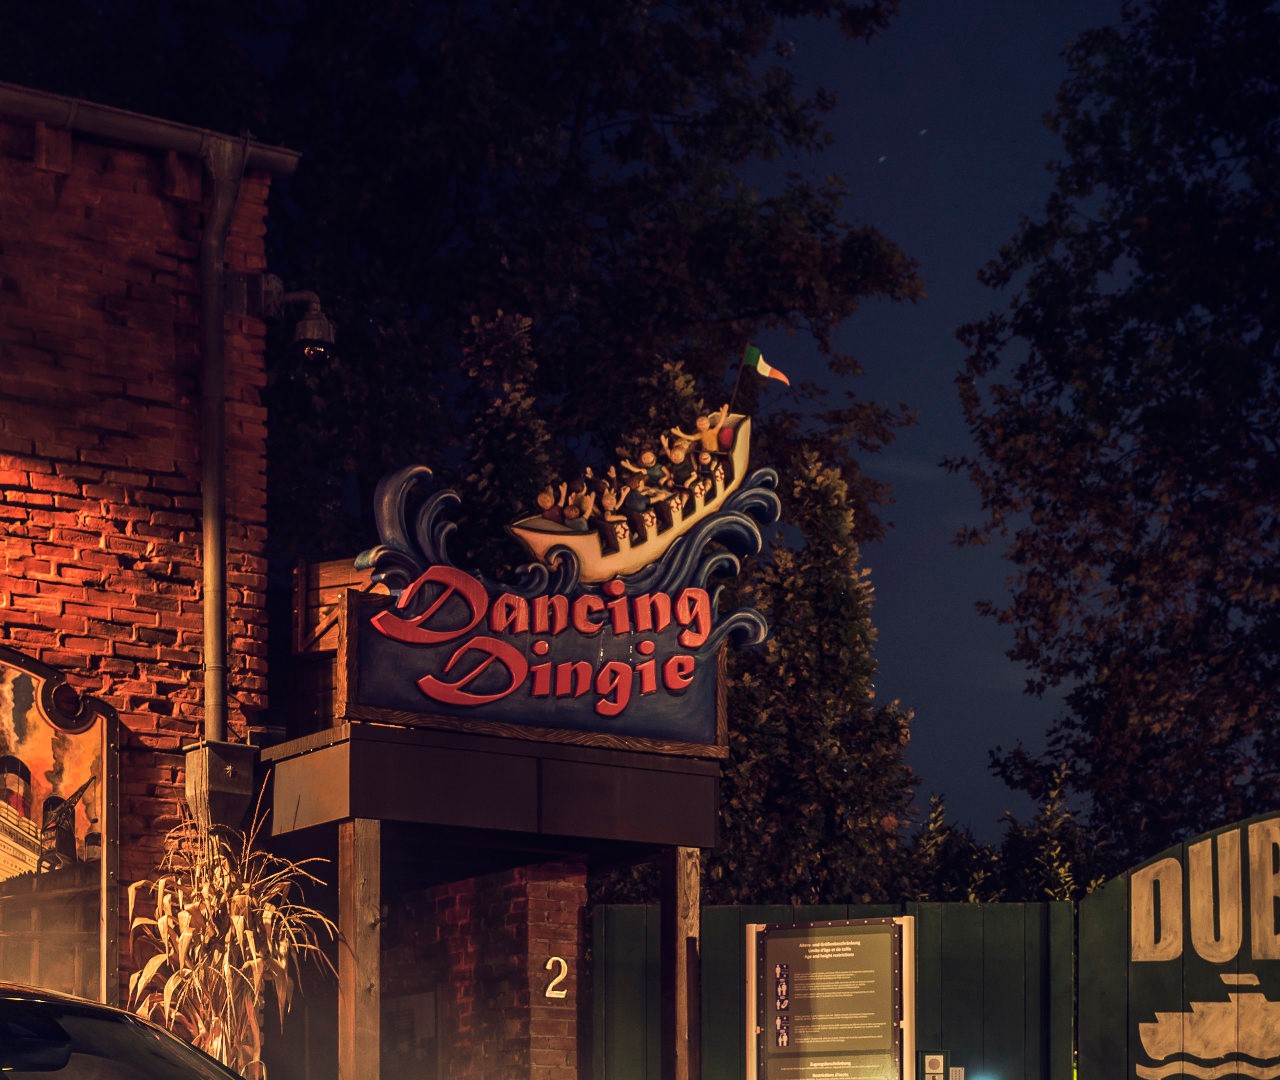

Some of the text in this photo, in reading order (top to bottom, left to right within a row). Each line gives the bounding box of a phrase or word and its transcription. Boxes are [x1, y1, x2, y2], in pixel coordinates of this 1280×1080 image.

[370, 565, 711, 649] Dancing
[417, 636, 696, 717] Dingie
[545, 956, 568, 998] 2
